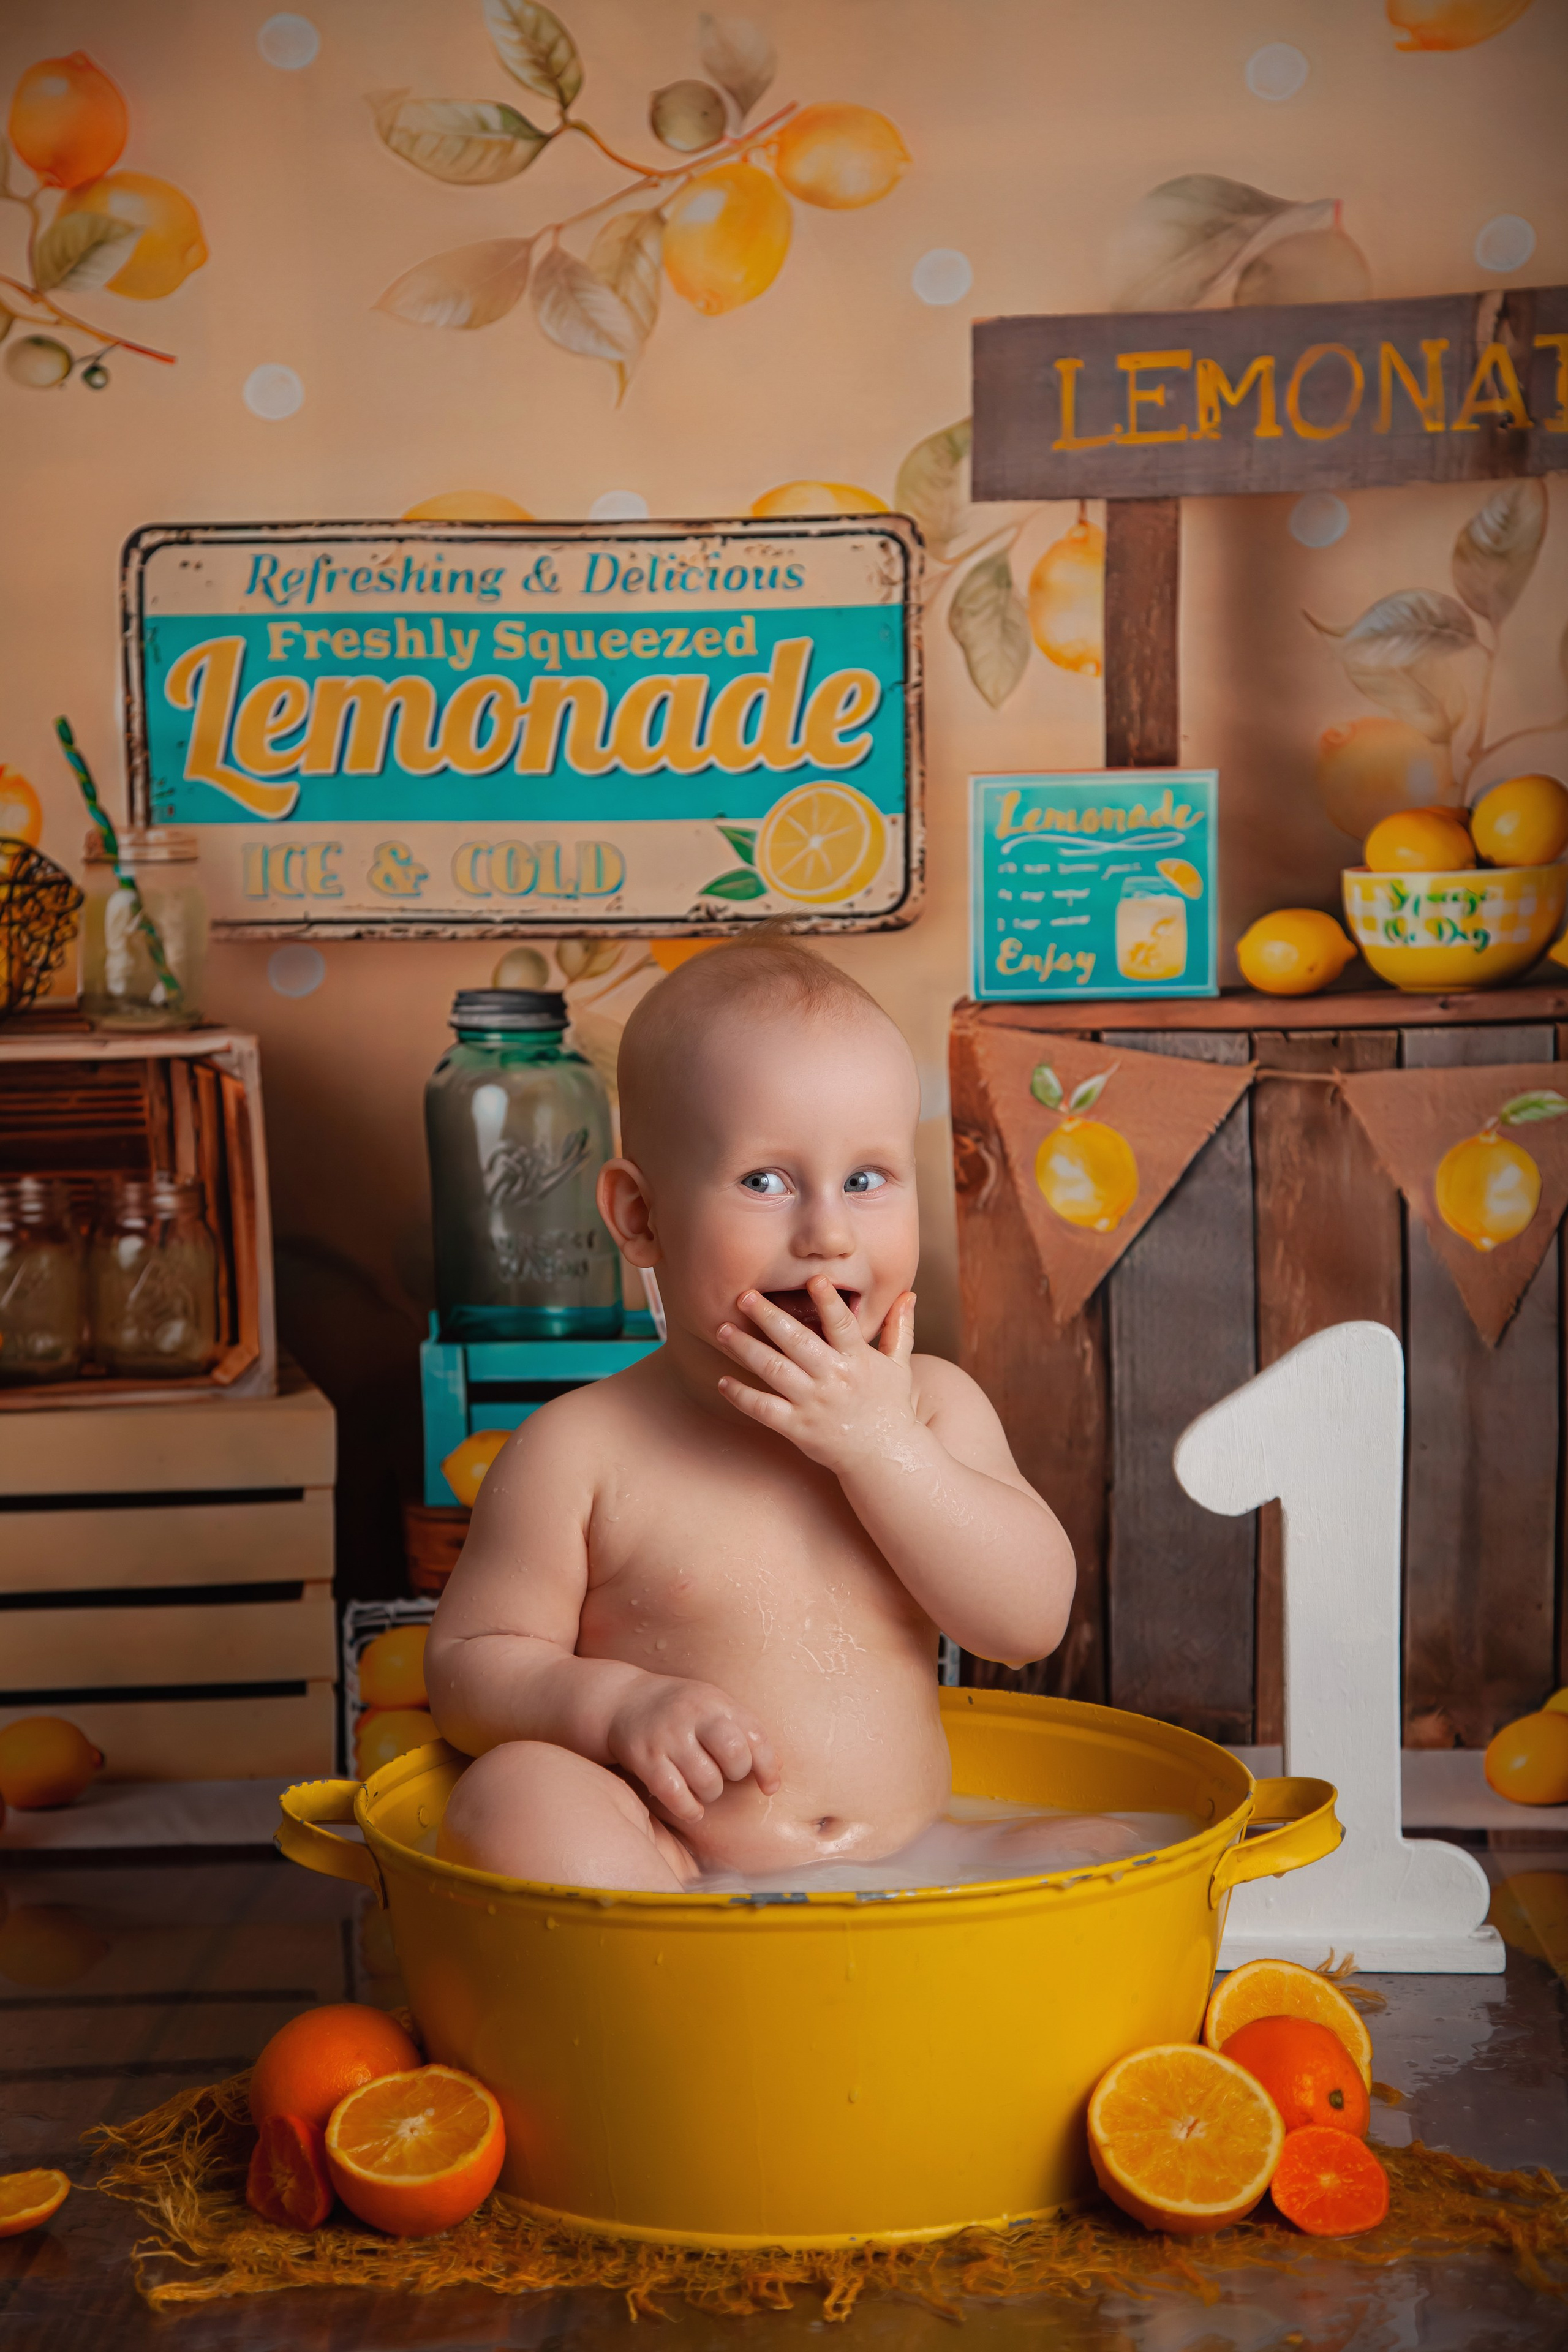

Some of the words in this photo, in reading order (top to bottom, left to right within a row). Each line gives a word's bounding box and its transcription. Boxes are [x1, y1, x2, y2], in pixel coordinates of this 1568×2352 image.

[245, 552, 506, 607] Refreshing
[522, 554, 562, 594] &
[580, 550, 807, 594] Delicious
[266, 617, 481, 671] Freshly
[492, 615, 759, 671] Squeezed
[164, 635, 883, 820] Lemonade
[996, 788, 1205, 840] Lemonade
[242, 840, 345, 900] ICE
[368, 839, 429, 899] &
[451, 839, 627, 899] COLD
[996, 937, 1096, 984] Enjoy
[1174, 1320, 1494, 1942] 1
